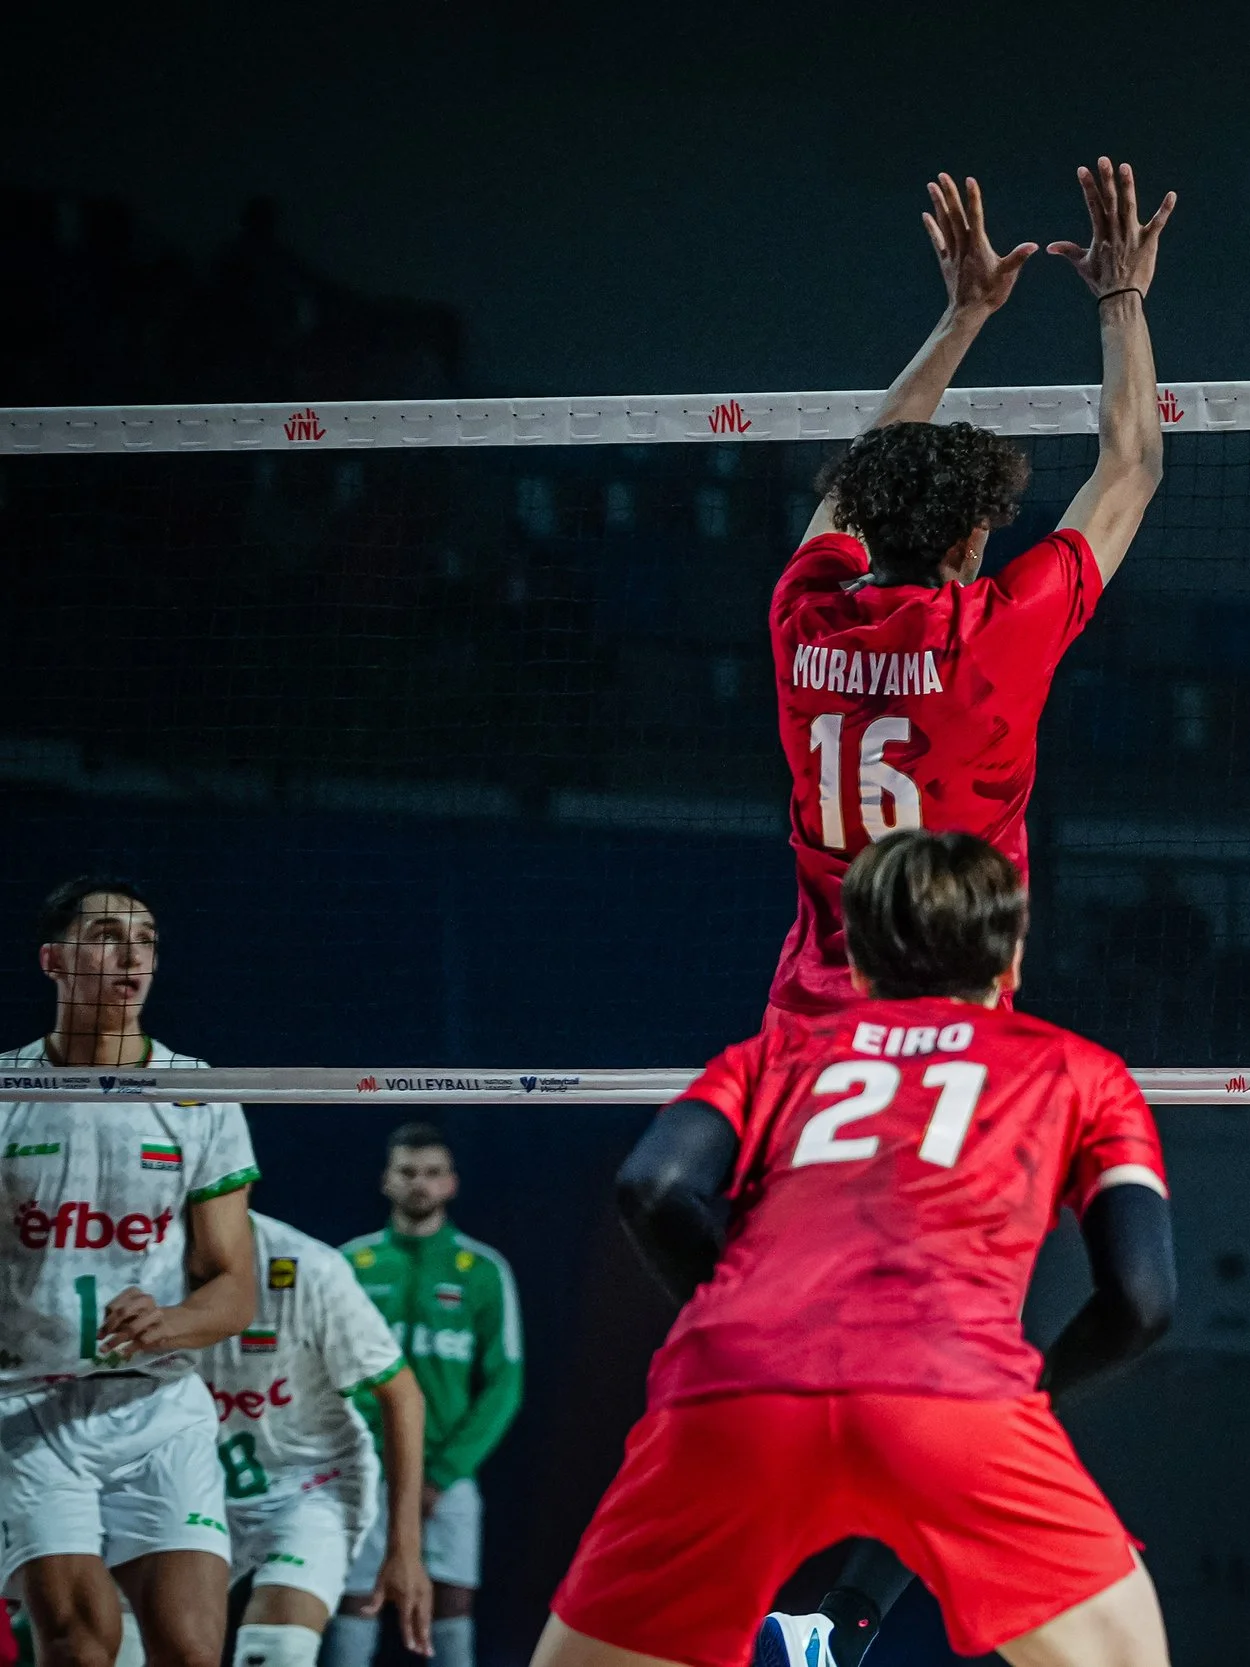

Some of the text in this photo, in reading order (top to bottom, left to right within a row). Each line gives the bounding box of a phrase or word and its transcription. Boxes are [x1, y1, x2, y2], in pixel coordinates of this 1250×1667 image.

[708, 400, 751, 434] VNL
[1157, 389, 1184, 422] NL
[284, 408, 326, 441] VNL
[793, 643, 943, 695] MURAYAMA
[810, 713, 922, 849] 16
[852, 1021, 974, 1056] EIRO
[0, 1077, 58, 1089] EYBALL
[385, 1078, 480, 1091] VOLLEYBALL
[791, 1060, 988, 1168] 21
